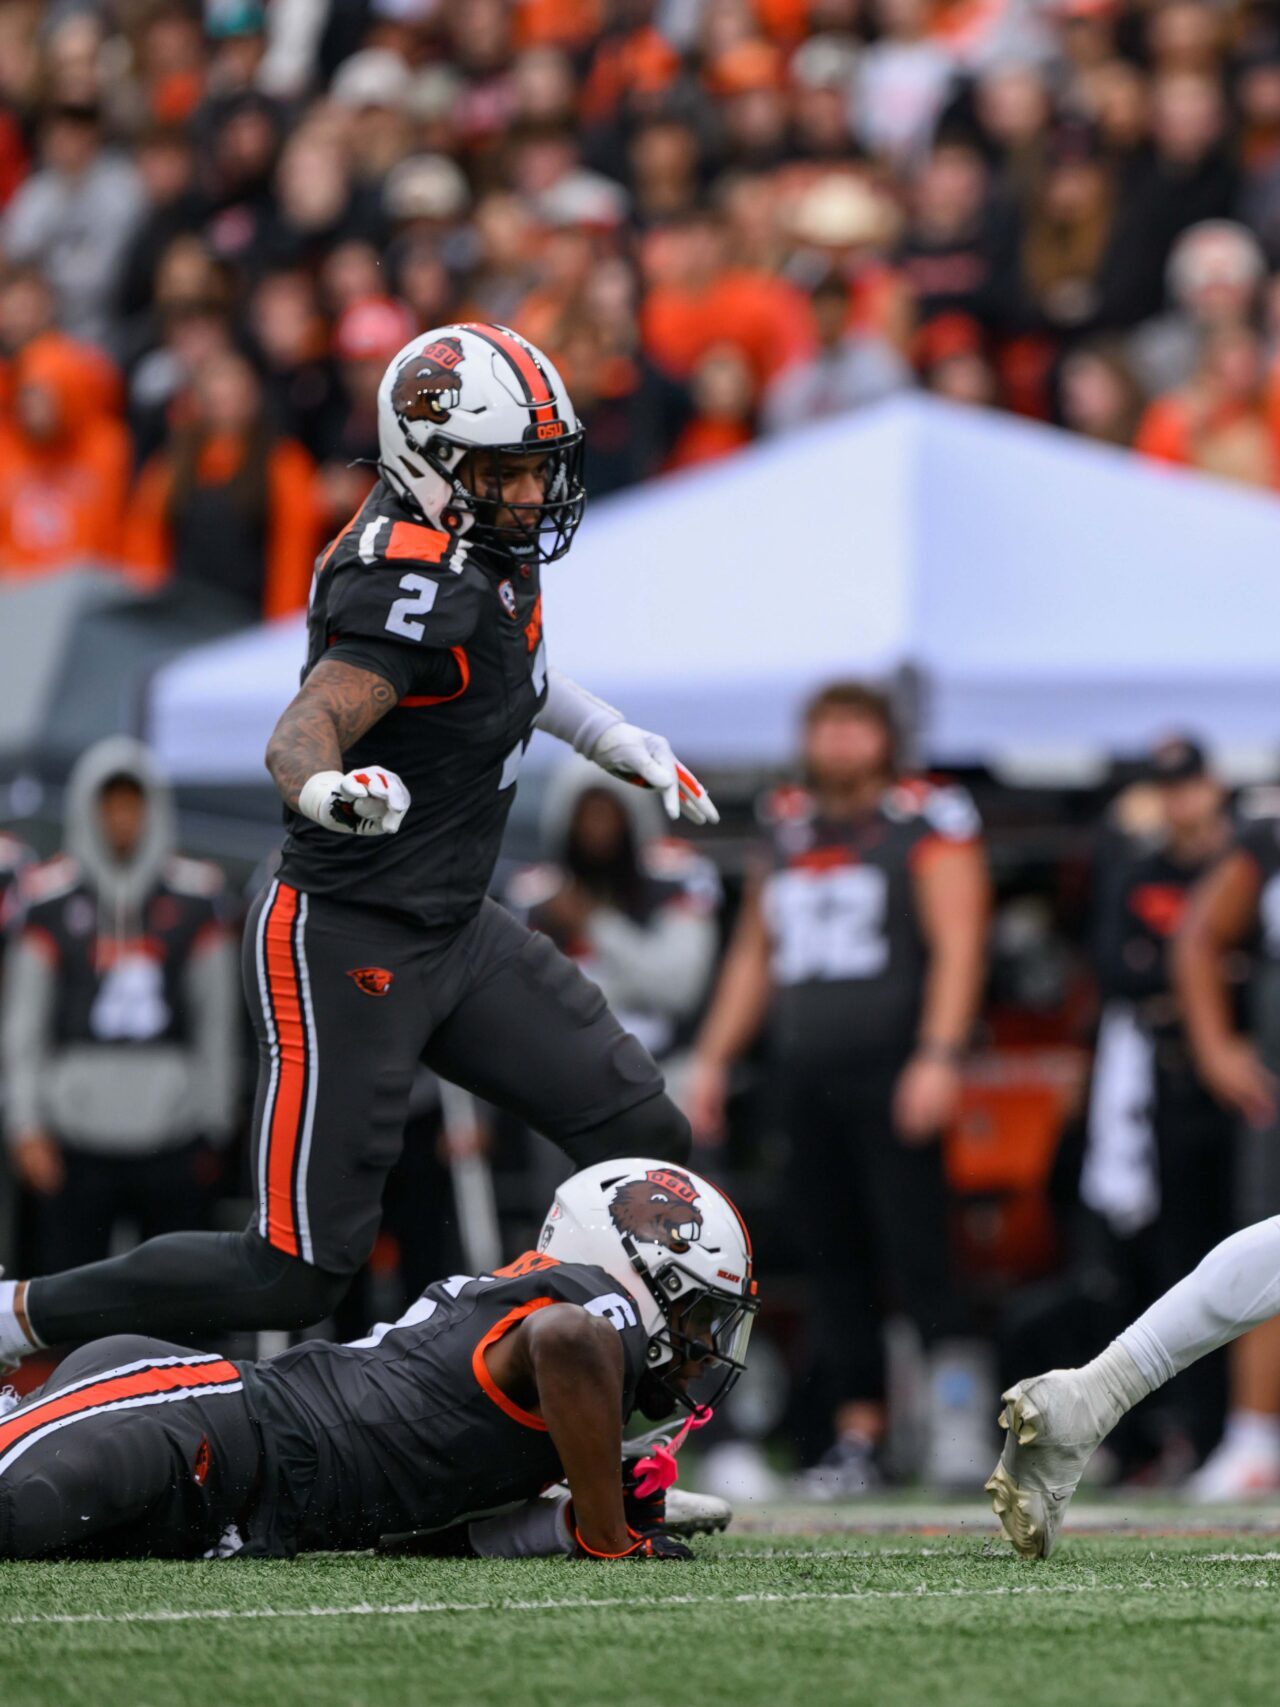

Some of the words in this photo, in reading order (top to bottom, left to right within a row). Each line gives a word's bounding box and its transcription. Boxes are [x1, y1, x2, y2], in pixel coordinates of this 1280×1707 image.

[424, 345, 459, 366] OSU
[537, 422, 562, 440] OSU
[384, 573, 439, 642] 2
[651, 1172, 692, 1198] OSU
[583, 1293, 637, 1331] 6
